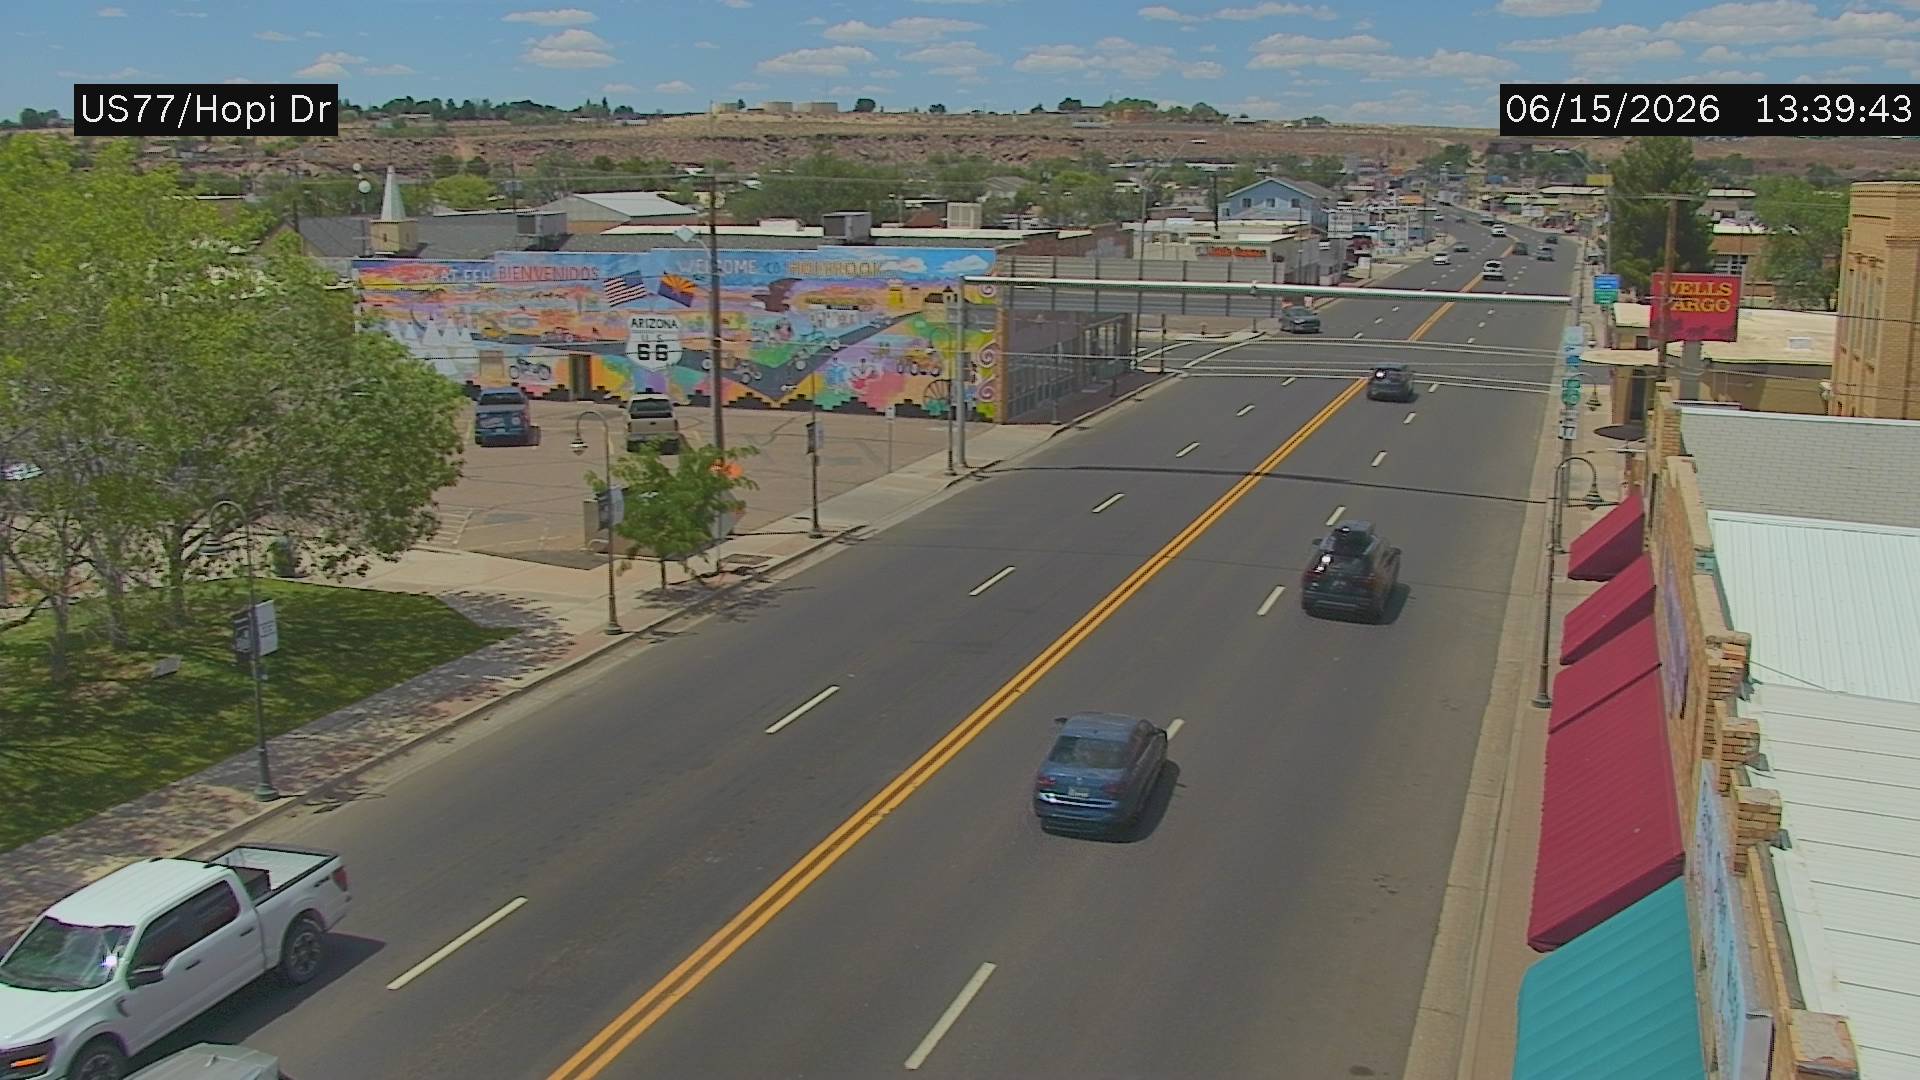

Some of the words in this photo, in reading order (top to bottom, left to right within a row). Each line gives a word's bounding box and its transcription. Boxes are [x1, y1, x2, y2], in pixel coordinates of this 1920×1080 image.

[499, 265, 600, 281] BIENVENIDOS
[1662, 298, 1732, 313] ARGO
[631, 318, 679, 329] ARIZONA
[637, 343, 668, 361] 66
